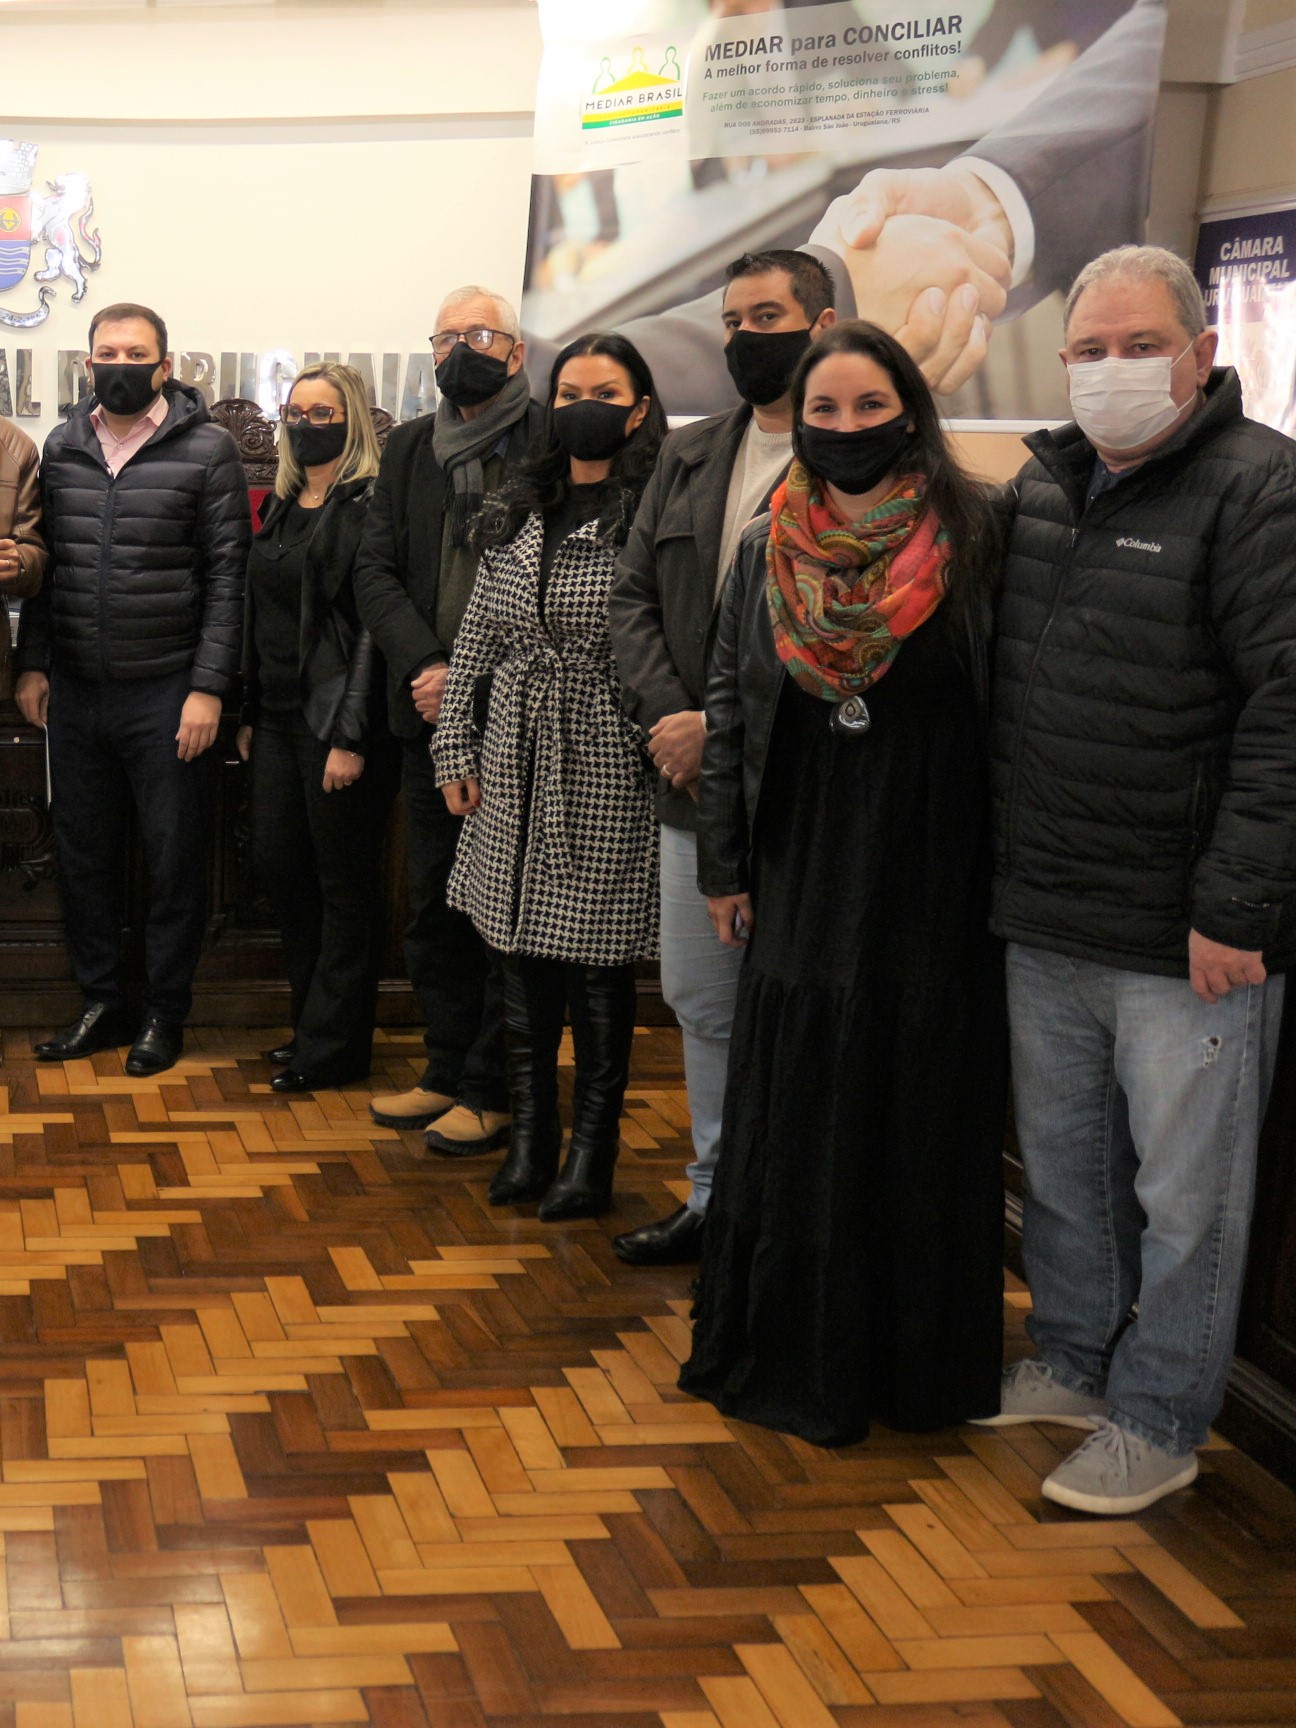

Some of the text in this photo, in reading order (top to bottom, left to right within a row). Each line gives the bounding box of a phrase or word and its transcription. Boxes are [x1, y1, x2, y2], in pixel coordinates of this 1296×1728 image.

[705, 15, 962, 61] MEDIAR para CONCILIAR
[704, 41, 962, 80] A melhor forma de resolver conflitos!
[703, 68, 960, 101] Fazer um acordo rápido, soluciona seu problema,
[710, 82, 949, 112] além de economizar tempo, dinheiro e stress!
[585, 87, 682, 110] MEDIAR BRASIL
[810, 114, 845, 123] ESPLANADA
[856, 109, 884, 119] ESTAÇÃO
[885, 107, 930, 116] FERROVIÁRIA
[1220, 236, 1284, 261] CÂMARA
[1208, 259, 1291, 286] MUNICIPAL
[1124, 537, 1162, 553] Columbia
